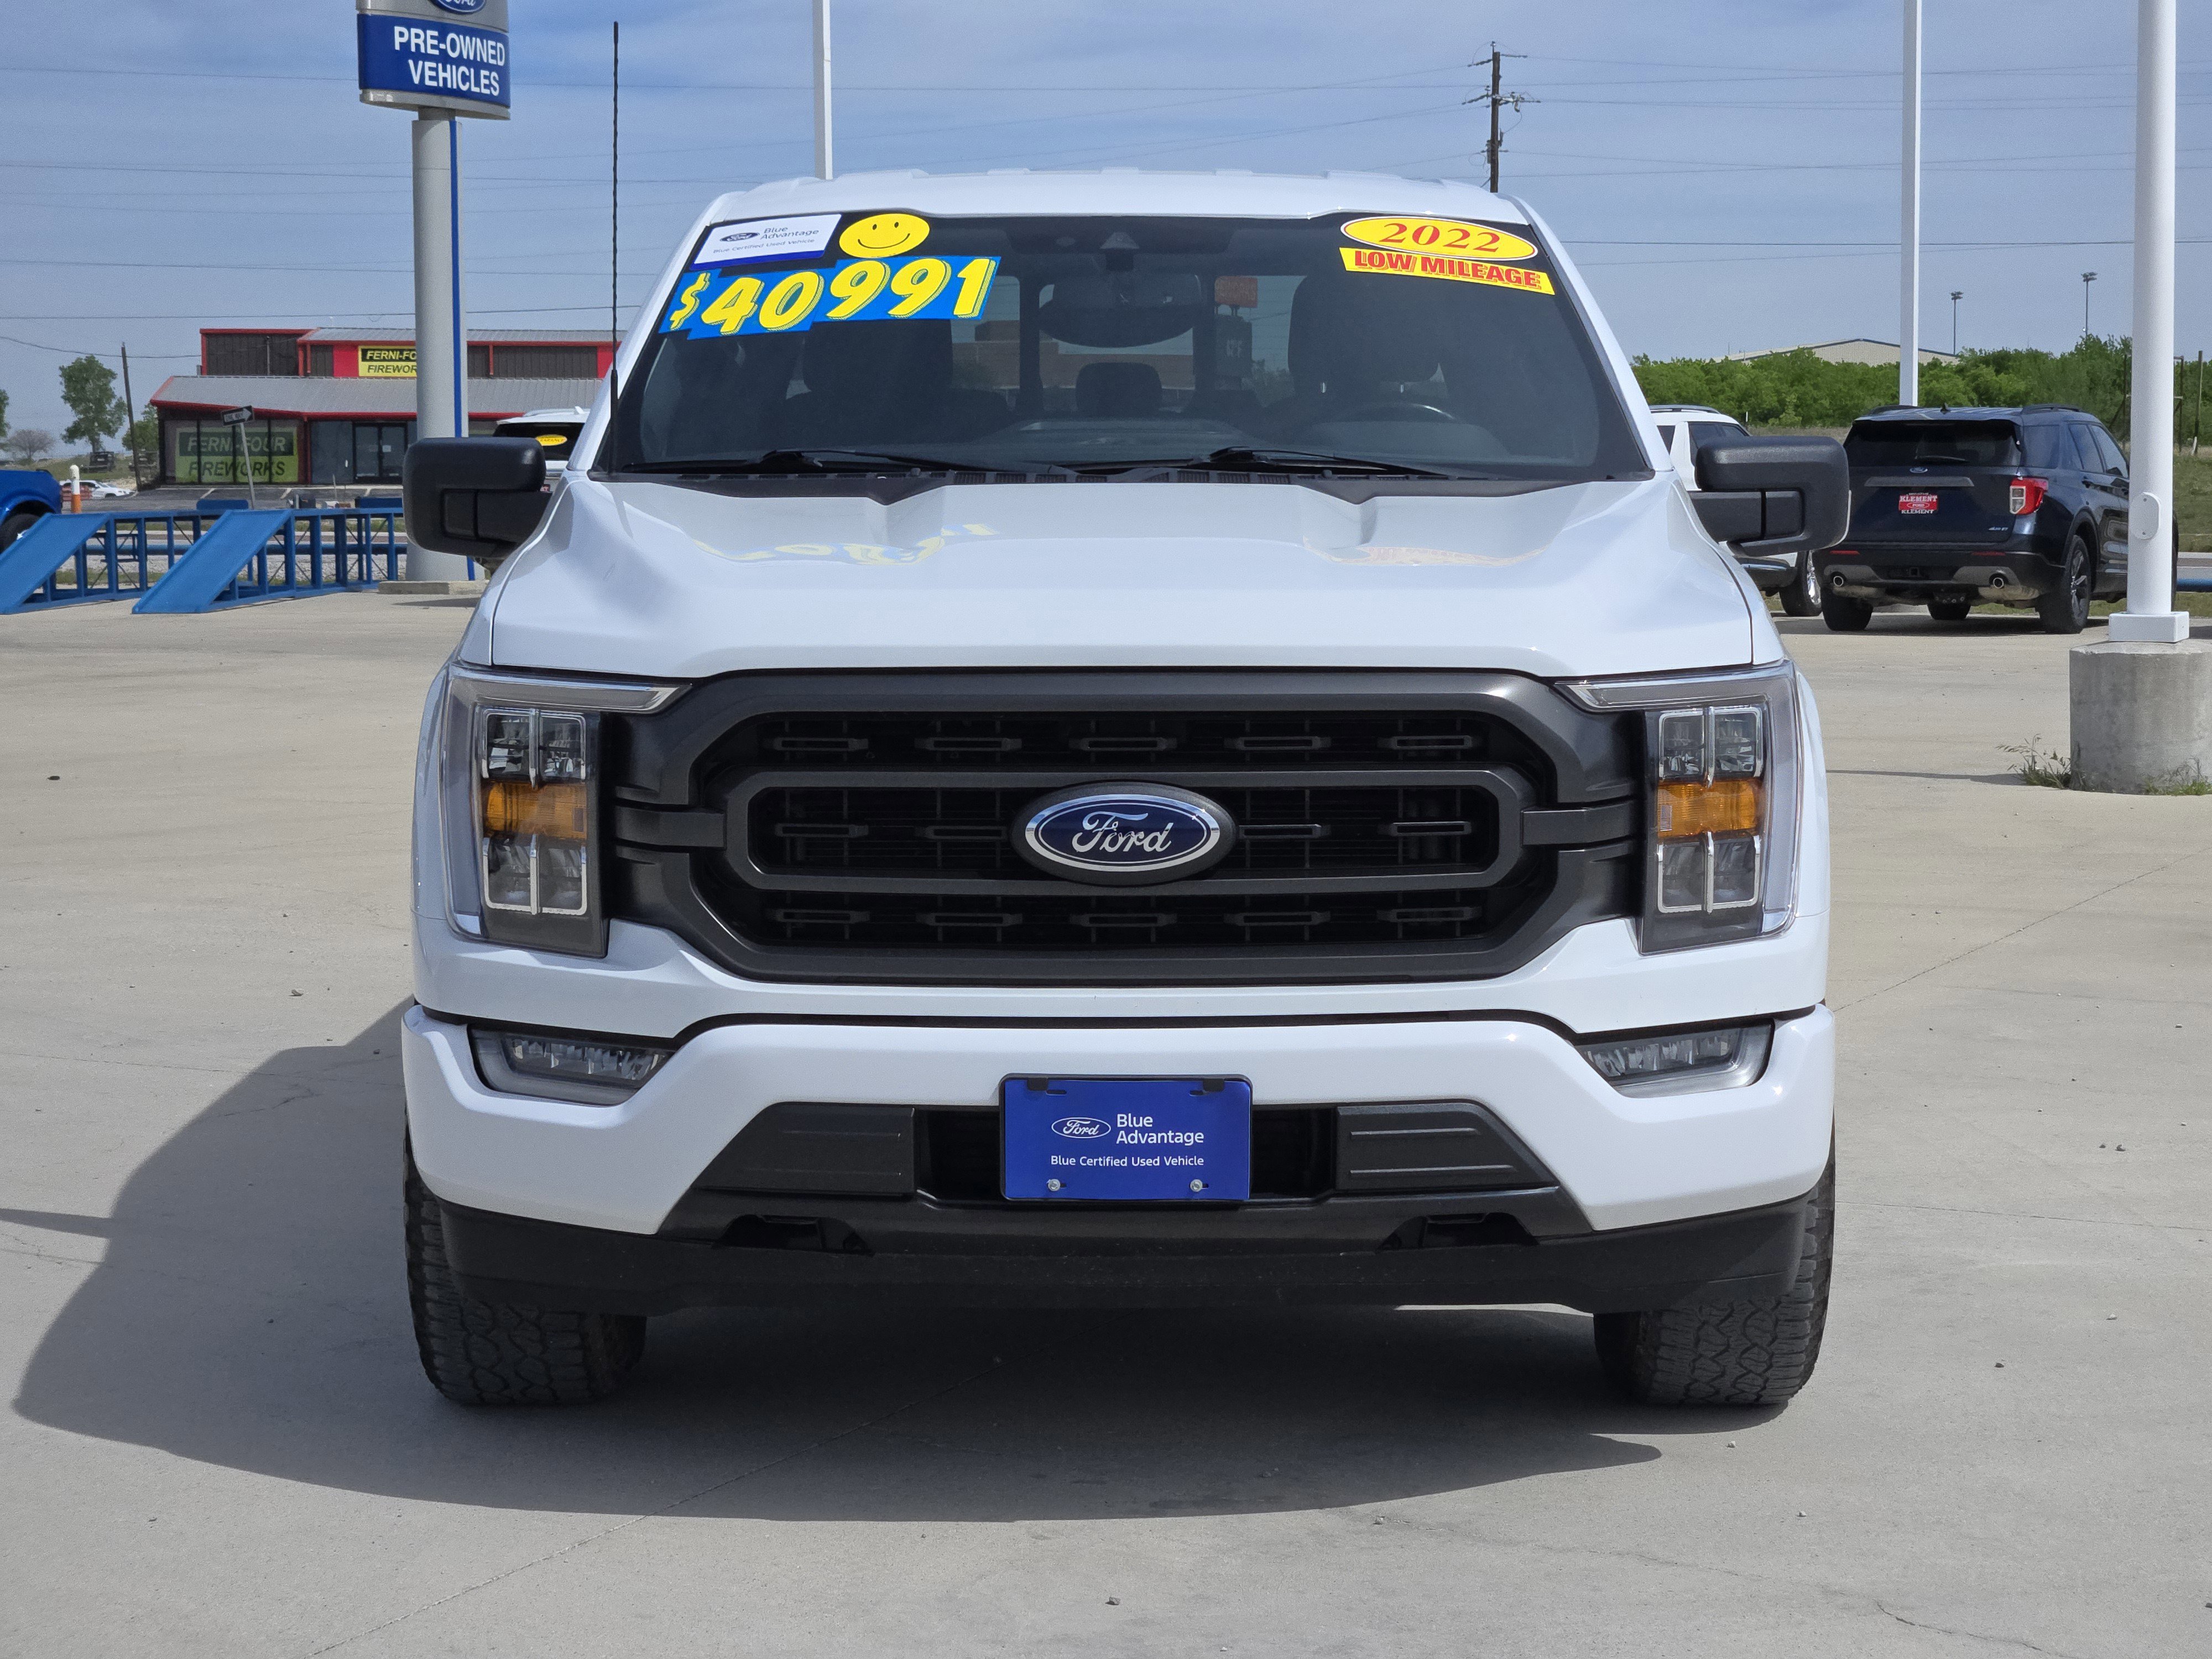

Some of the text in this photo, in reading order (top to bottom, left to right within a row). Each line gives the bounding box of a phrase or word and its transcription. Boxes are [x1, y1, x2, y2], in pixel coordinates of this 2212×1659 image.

[394, 26, 505, 66] PRE-OWNED
[408, 59, 500, 96] VEHICLES
[760, 230, 819, 240] Advantage
[1379, 223, 1500, 253] 2022
[1354, 251, 1542, 290] LOW MILEAGE
[670, 258, 997, 335] $40991
[1072, 811, 1174, 853] Ford
[1062, 1119, 1099, 1135] Ford
[1117, 1113, 1153, 1128] Blue
[1116, 1130, 1204, 1146] Advantage
[1051, 1155, 1204, 1167] Blue Certified Used Vehicle
